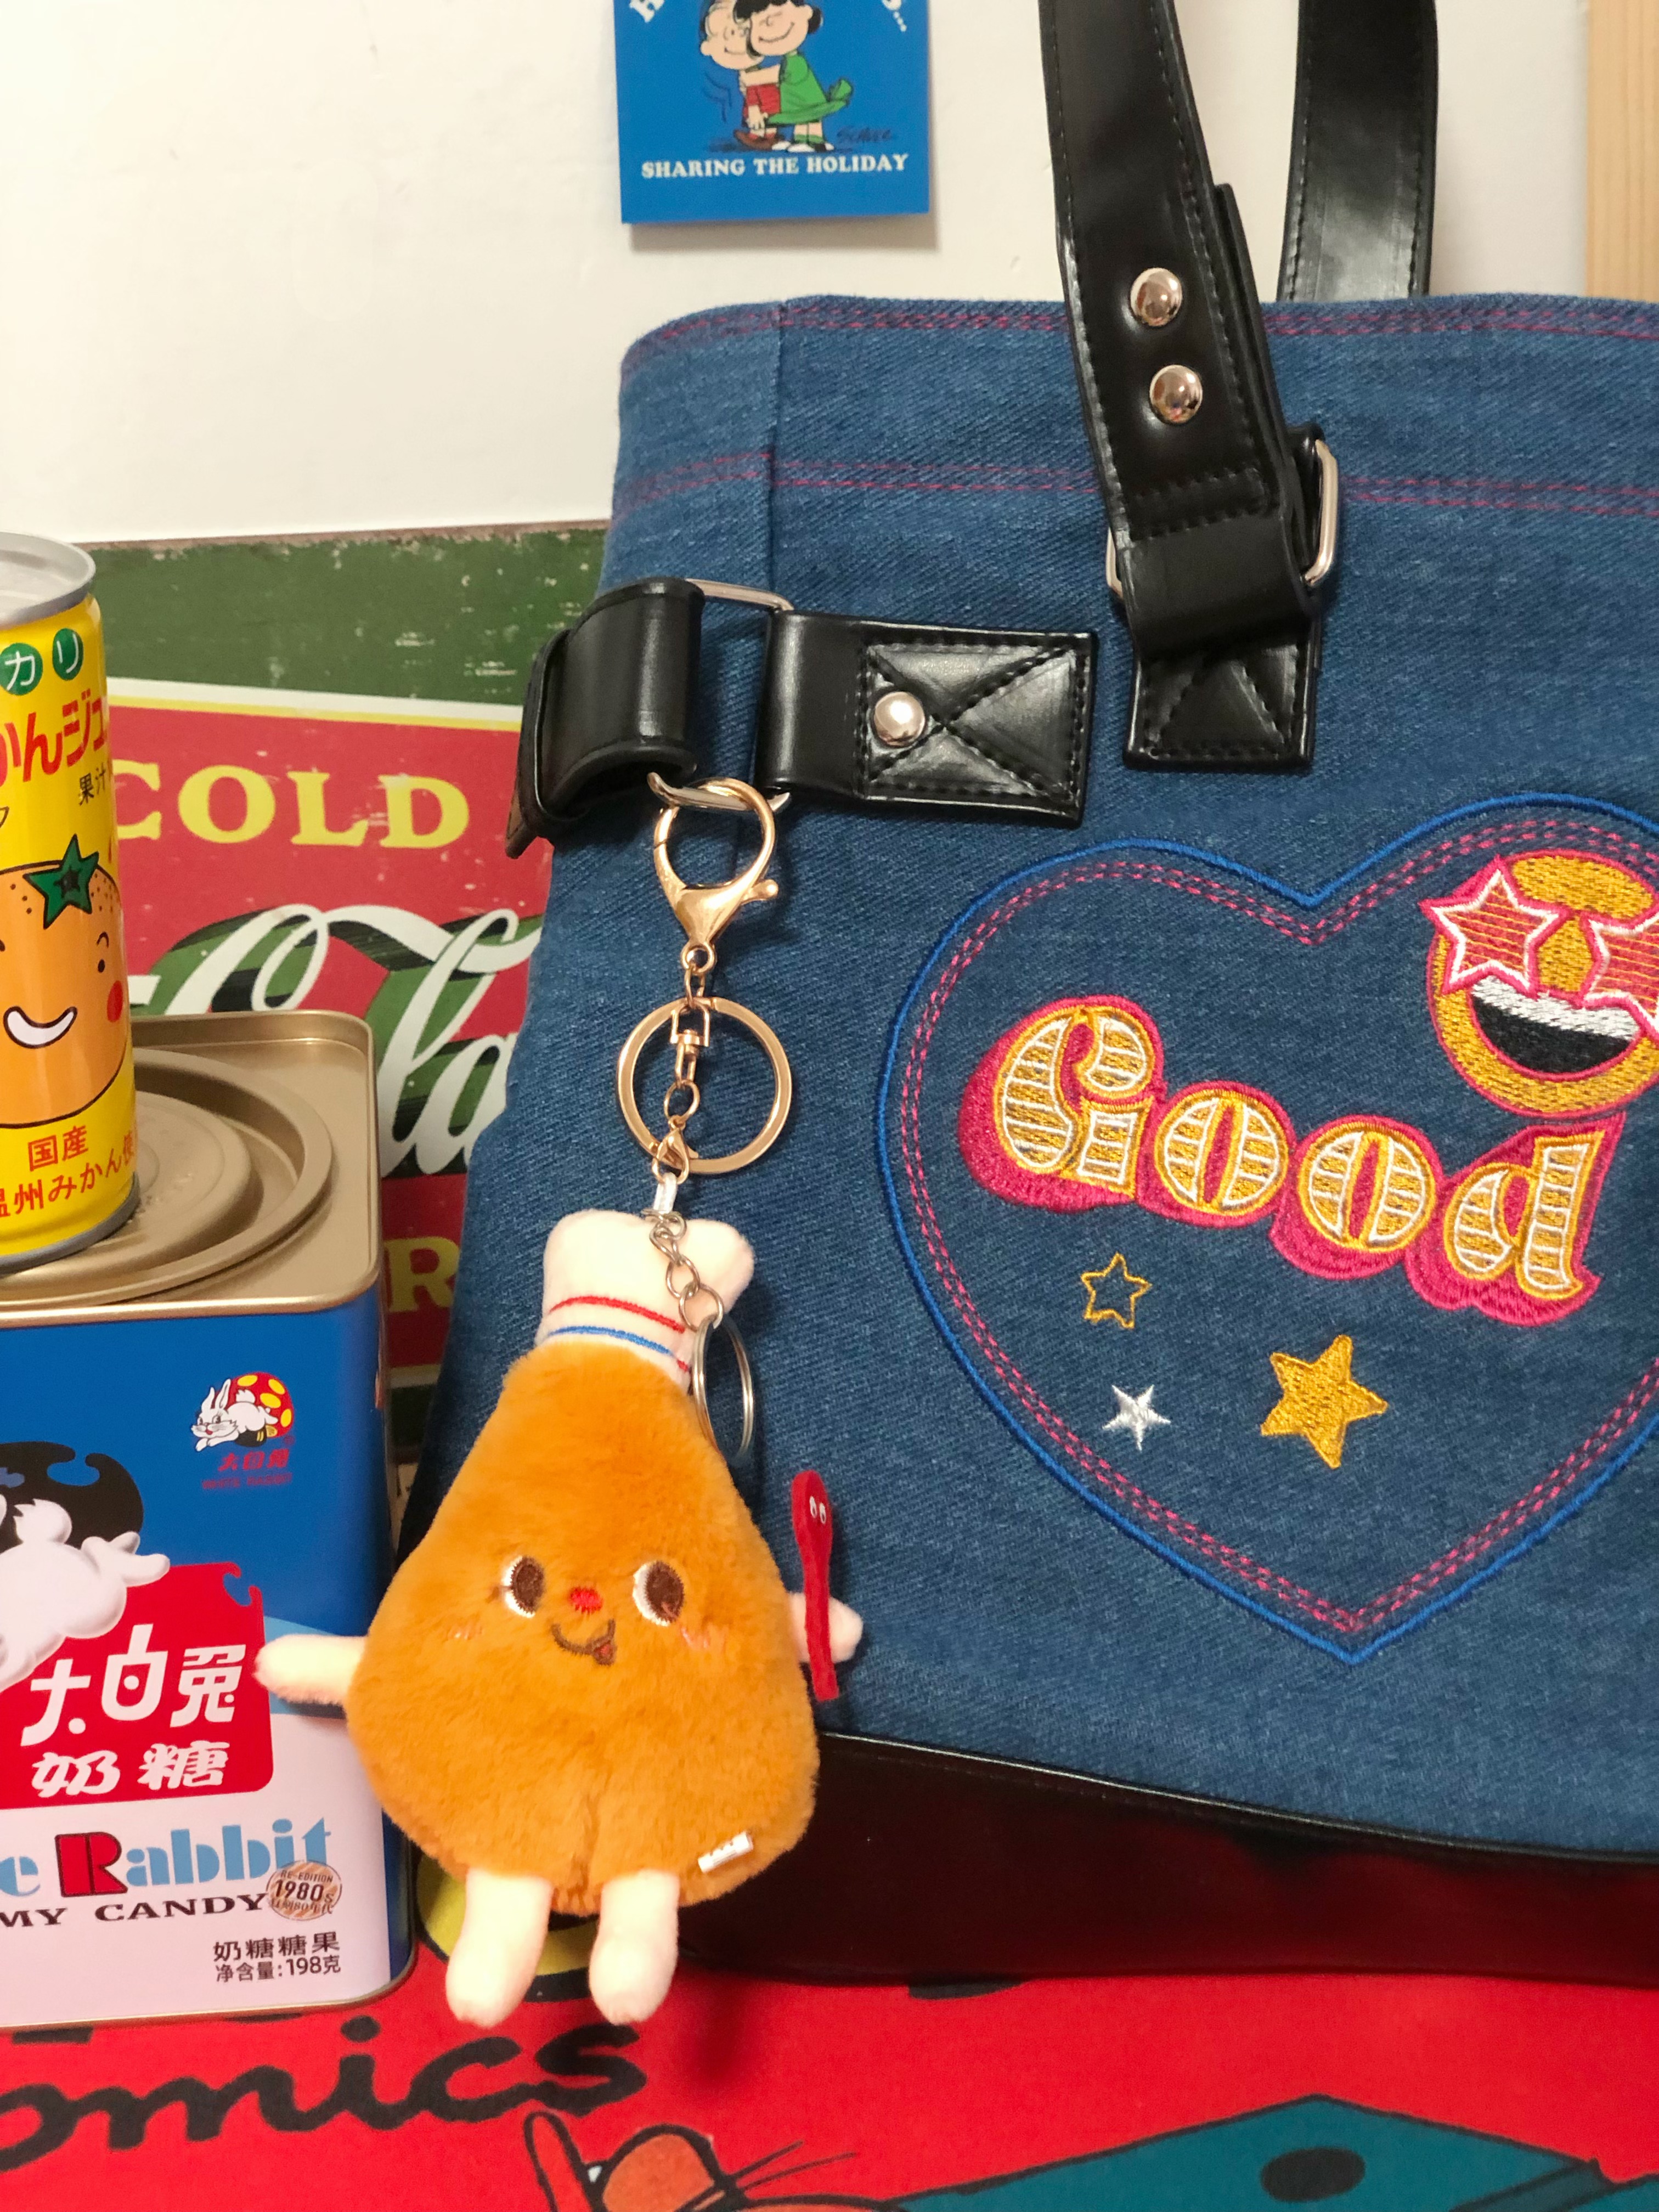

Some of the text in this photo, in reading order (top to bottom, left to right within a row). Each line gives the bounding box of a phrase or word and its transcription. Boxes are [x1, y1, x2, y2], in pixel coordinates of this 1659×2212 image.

[641, 154, 909, 178] SHARING THE HOLIDAY
[28, 1125, 89, 1172] 国産
[991, 1001, 1607, 1302] Good
[31, 1740, 230, 1798] 奶糖
[55, 1817, 331, 1898] Rabbit
[94, 1893, 268, 1921] CANDY
[213, 1931, 340, 1962] 奶糖糖果
[216, 1954, 341, 1983] 净含量:198克
